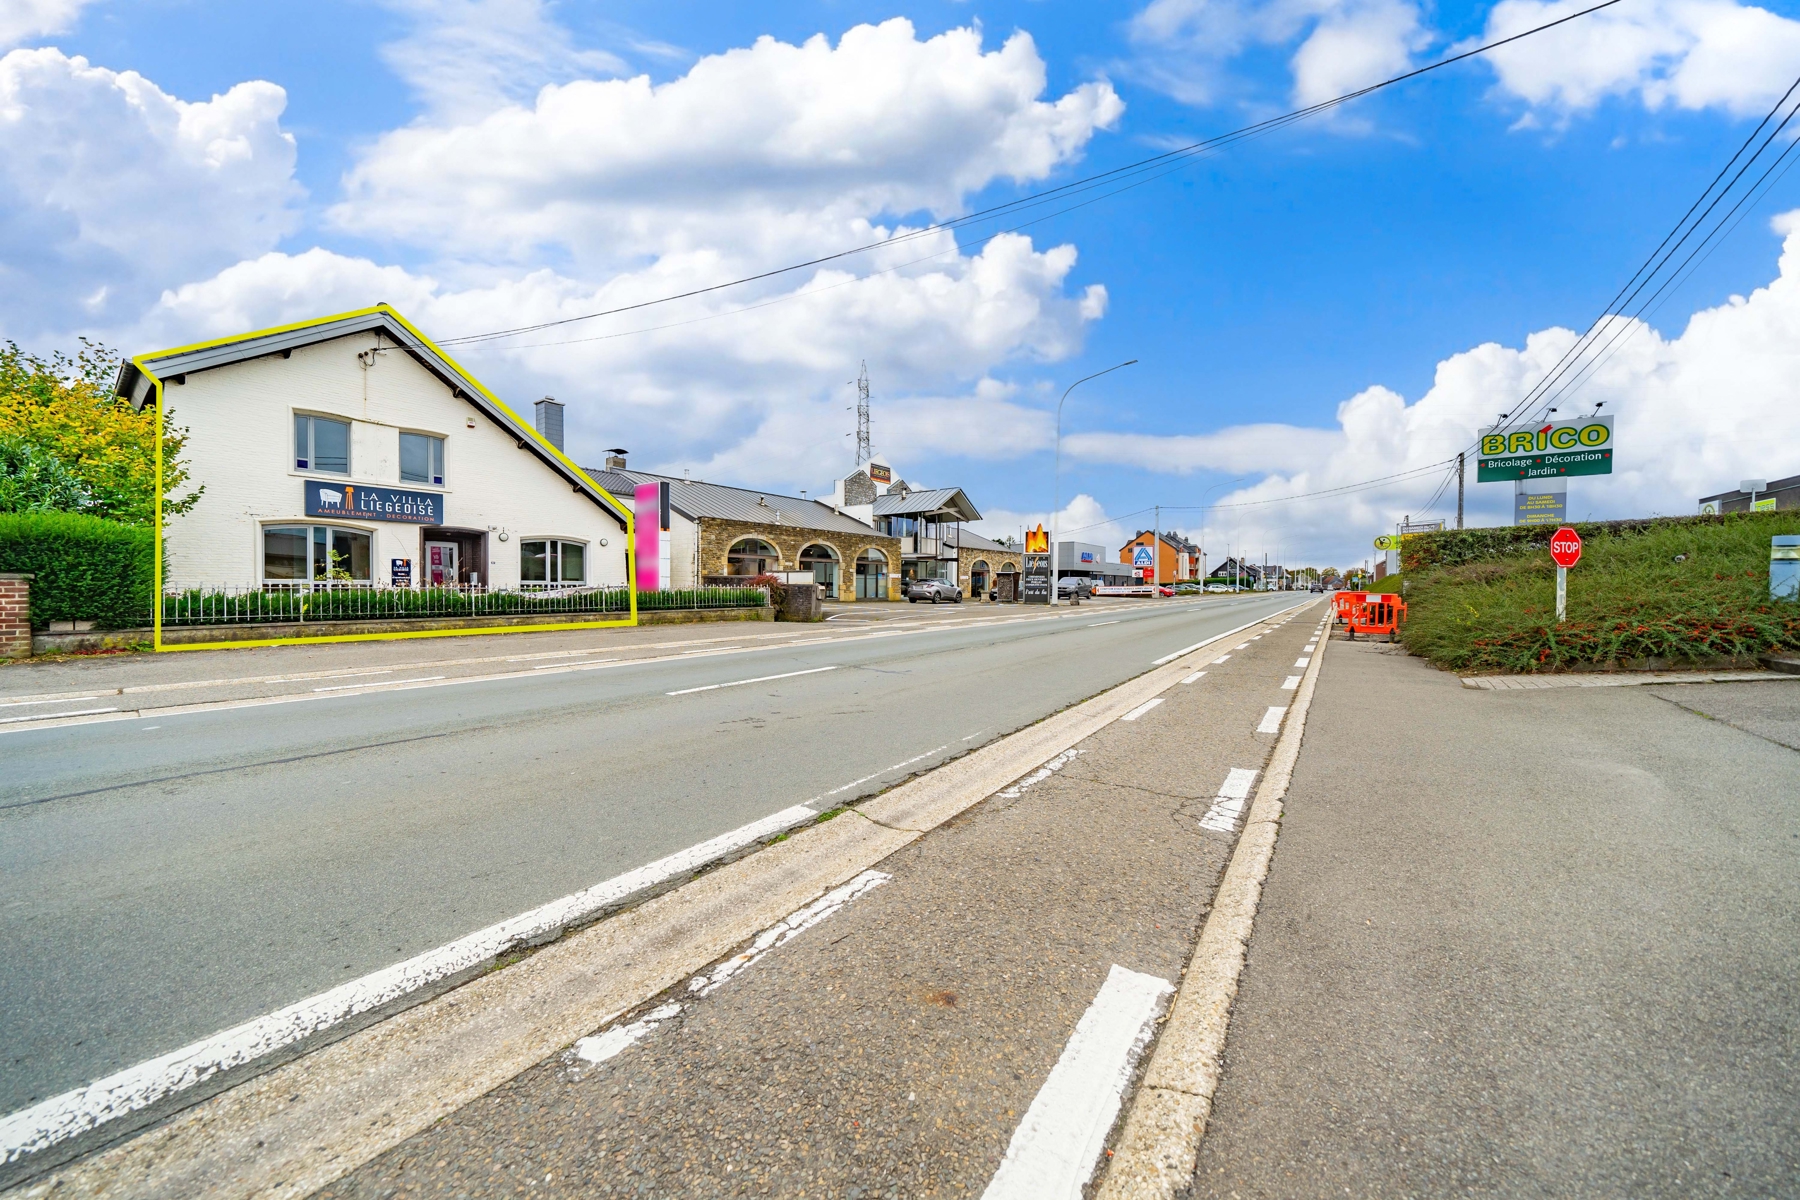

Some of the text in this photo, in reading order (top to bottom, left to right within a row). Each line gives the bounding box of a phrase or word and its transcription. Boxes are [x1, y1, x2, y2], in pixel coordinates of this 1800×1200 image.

[1481, 424, 1611, 456] BRICO
[1488, 453, 1602, 469] Bricolage Décoration
[1528, 466, 1557, 477] Jardin
[361, 491, 433, 506] LA VILLA
[317, 508, 435, 522] AMEUBLEMENT DECORATION
[361, 500, 434, 516] LIEGEOISE
[1553, 541, 1579, 554] STOP
